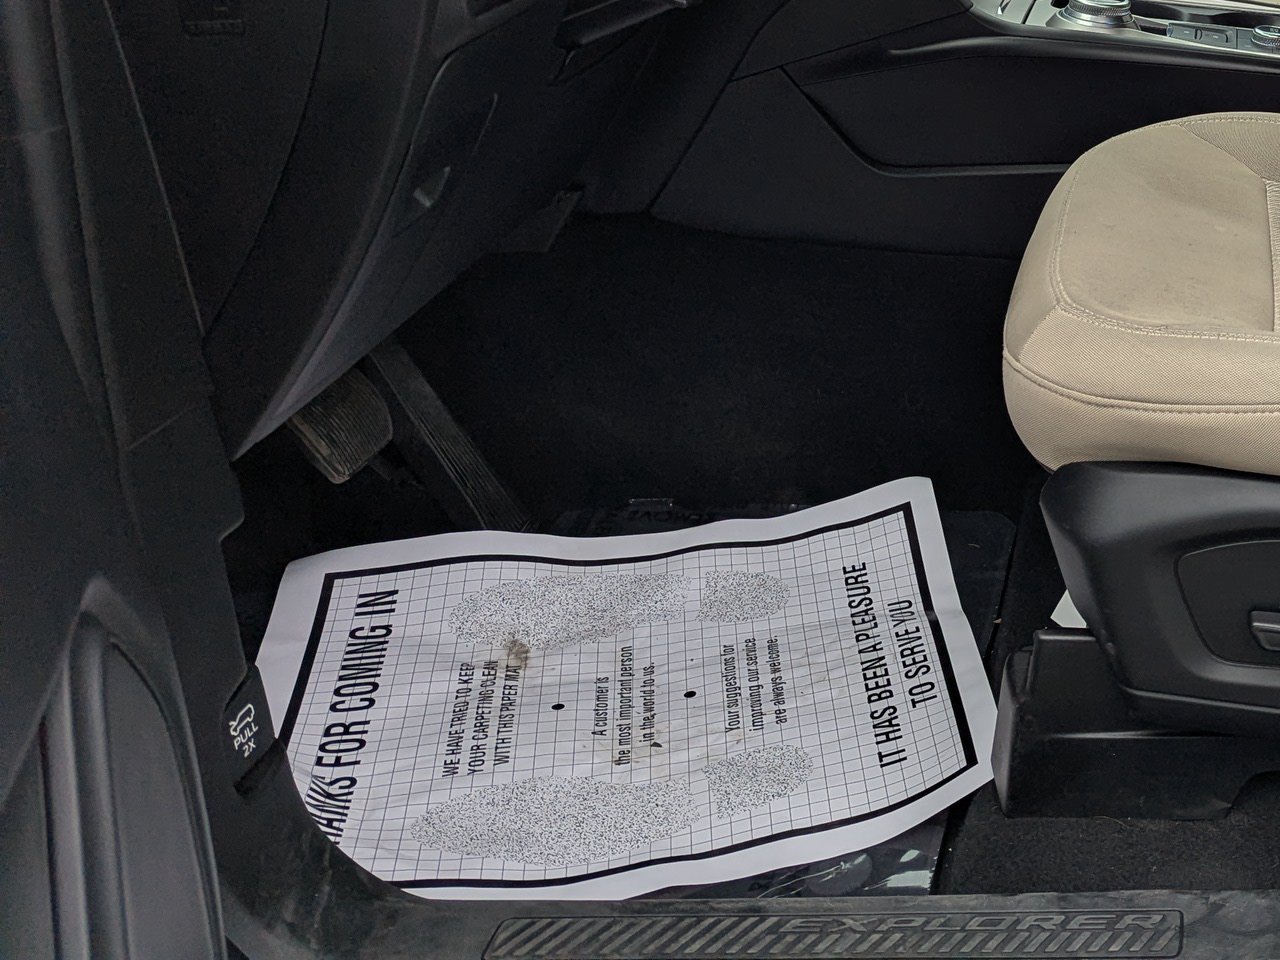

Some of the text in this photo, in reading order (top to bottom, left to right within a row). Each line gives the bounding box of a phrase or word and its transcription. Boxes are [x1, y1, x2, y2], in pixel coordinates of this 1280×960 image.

[354, 589, 399, 616] IN
[329, 624, 393, 713] COMING
[842, 562, 908, 768] IT HAS BEEN A PLEASURE
[887, 599, 938, 708] TO SERVE YOU
[594, 676, 609, 685] is
[640, 678, 655, 688] to
[720, 644, 741, 734] Your suggestions for
[742, 638, 766, 731] improving our service
[770, 676, 786, 706] always
[467, 661, 499, 776] YOUR CARPETING CLEAN
[493, 664, 522, 766] WITH THIS PAPER MAT
[593, 686, 609, 727] customer
[615, 645, 635, 766] the most important person
[640, 689, 655, 714] world
[775, 708, 788, 725] are
[233, 722, 258, 750] PULL
[442, 662, 476, 777] WE HAVE TRIED TO KEEP
[640, 716, 656, 730] the
[243, 738, 256, 757] 2X
[316, 720, 371, 767] FOR
[639, 733, 655, 743] in
[780, 913, 1166, 933] EXPLORER
